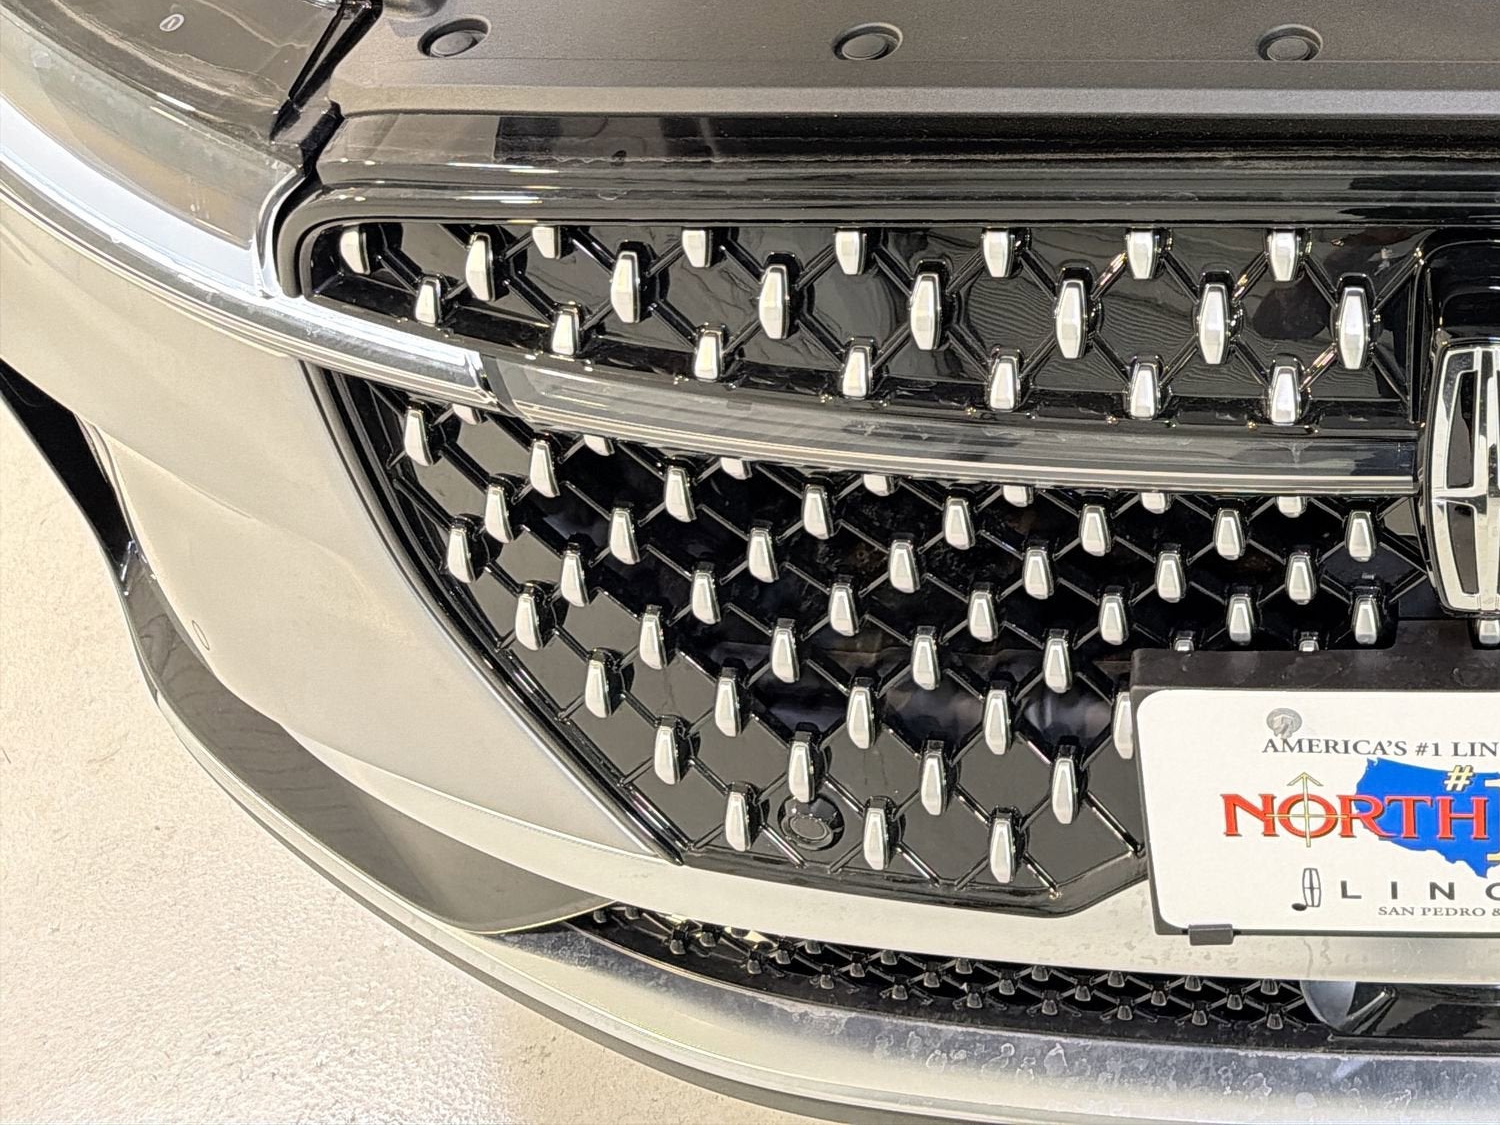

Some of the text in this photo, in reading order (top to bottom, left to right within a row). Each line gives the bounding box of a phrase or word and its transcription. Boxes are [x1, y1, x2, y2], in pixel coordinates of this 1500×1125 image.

[1261, 737, 1408, 757] AMERICA'S
[1415, 741, 1443, 757] #1
[1220, 792, 1490, 840] NORTH
[1377, 905, 1415, 917] SAN
[1420, 906, 1486, 917] PEDRO
